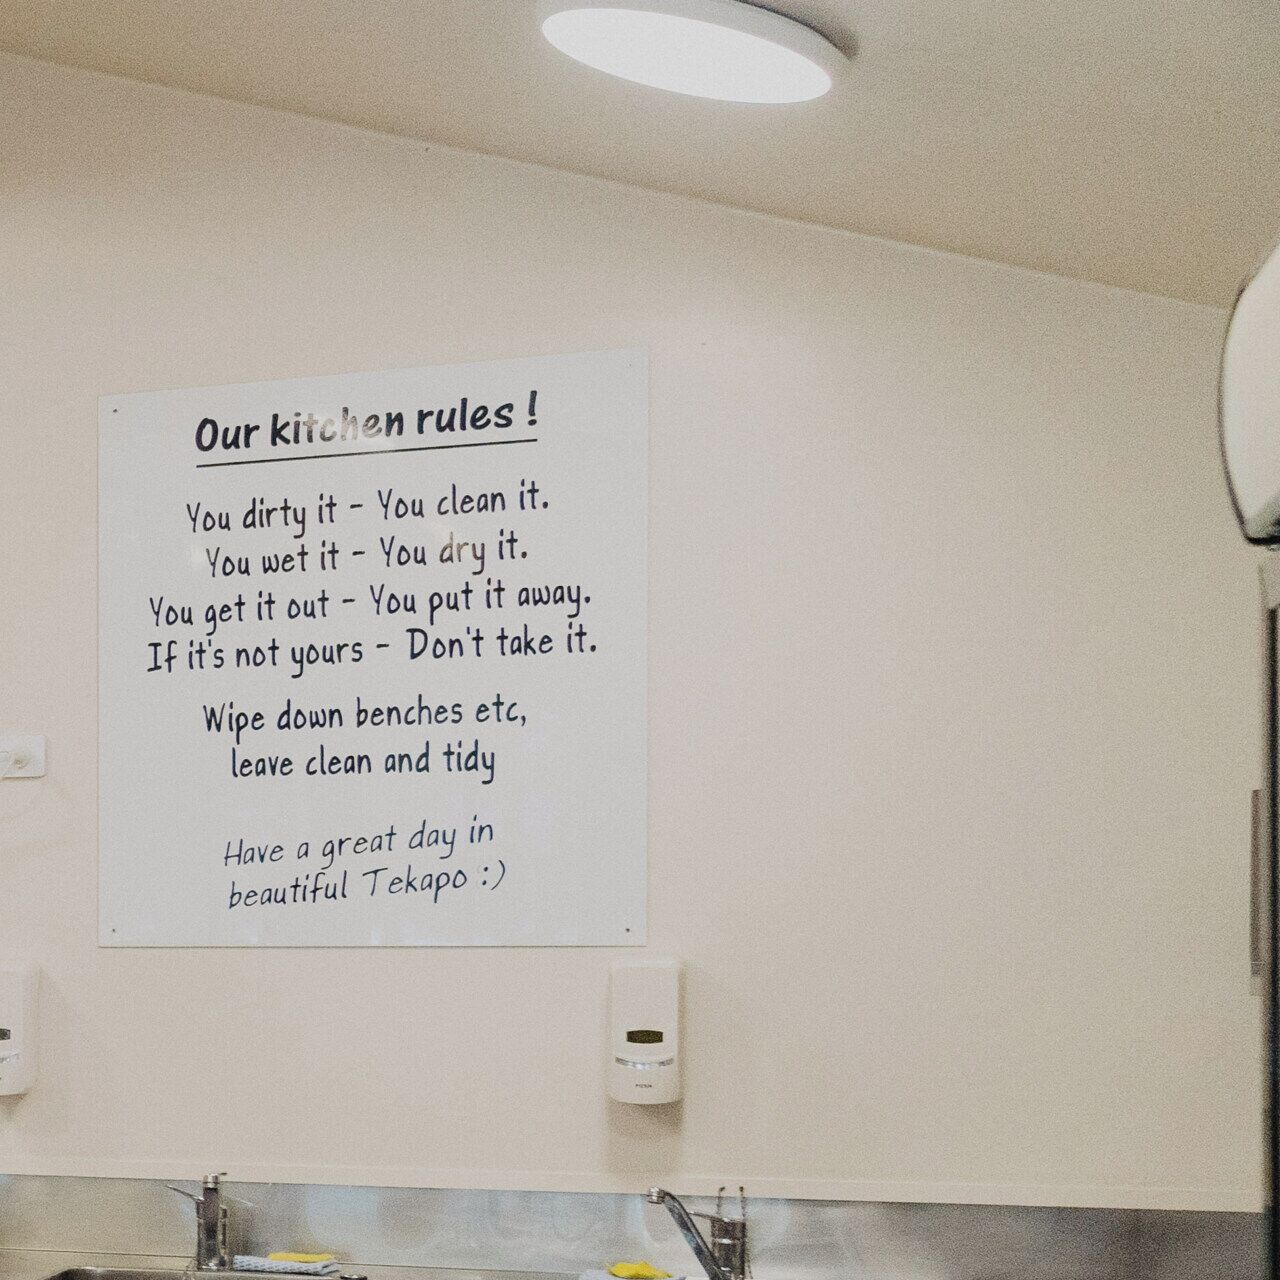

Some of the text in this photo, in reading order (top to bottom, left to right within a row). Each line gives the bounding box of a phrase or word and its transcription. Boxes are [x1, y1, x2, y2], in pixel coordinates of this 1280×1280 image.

[194, 389, 538, 453] Our kitchen rules !
[185, 501, 232, 534] You
[242, 496, 307, 540] dirty
[317, 492, 338, 525] it
[376, 487, 425, 521] You
[436, 482, 507, 516] clean
[518, 478, 549, 511] it.
[205, 546, 251, 579] You
[261, 543, 310, 575] wet
[320, 539, 340, 572] it
[379, 535, 428, 568] You
[438, 531, 486, 577] dry
[497, 528, 528, 561] it.
[148, 595, 194, 628] You
[204, 593, 247, 637] get
[256, 589, 277, 622] it
[286, 588, 330, 620] out
[369, 583, 418, 616] You
[428, 580, 474, 627] put
[485, 576, 506, 610] it
[517, 584, 592, 620] away.
[146, 639, 178, 674] If
[187, 638, 225, 671] it's
[235, 637, 281, 668] not
[290, 641, 364, 680] yours
[405, 625, 485, 661] Don't
[495, 623, 554, 657] take
[566, 620, 597, 654] it.
[202, 692, 527, 746] Wipe down benches etc,
[231, 738, 496, 786] leave clean and tidy
[223, 814, 494, 874] Have a great day in
[228, 869, 348, 910] beautiful
[361, 864, 468, 904] Tekapo
